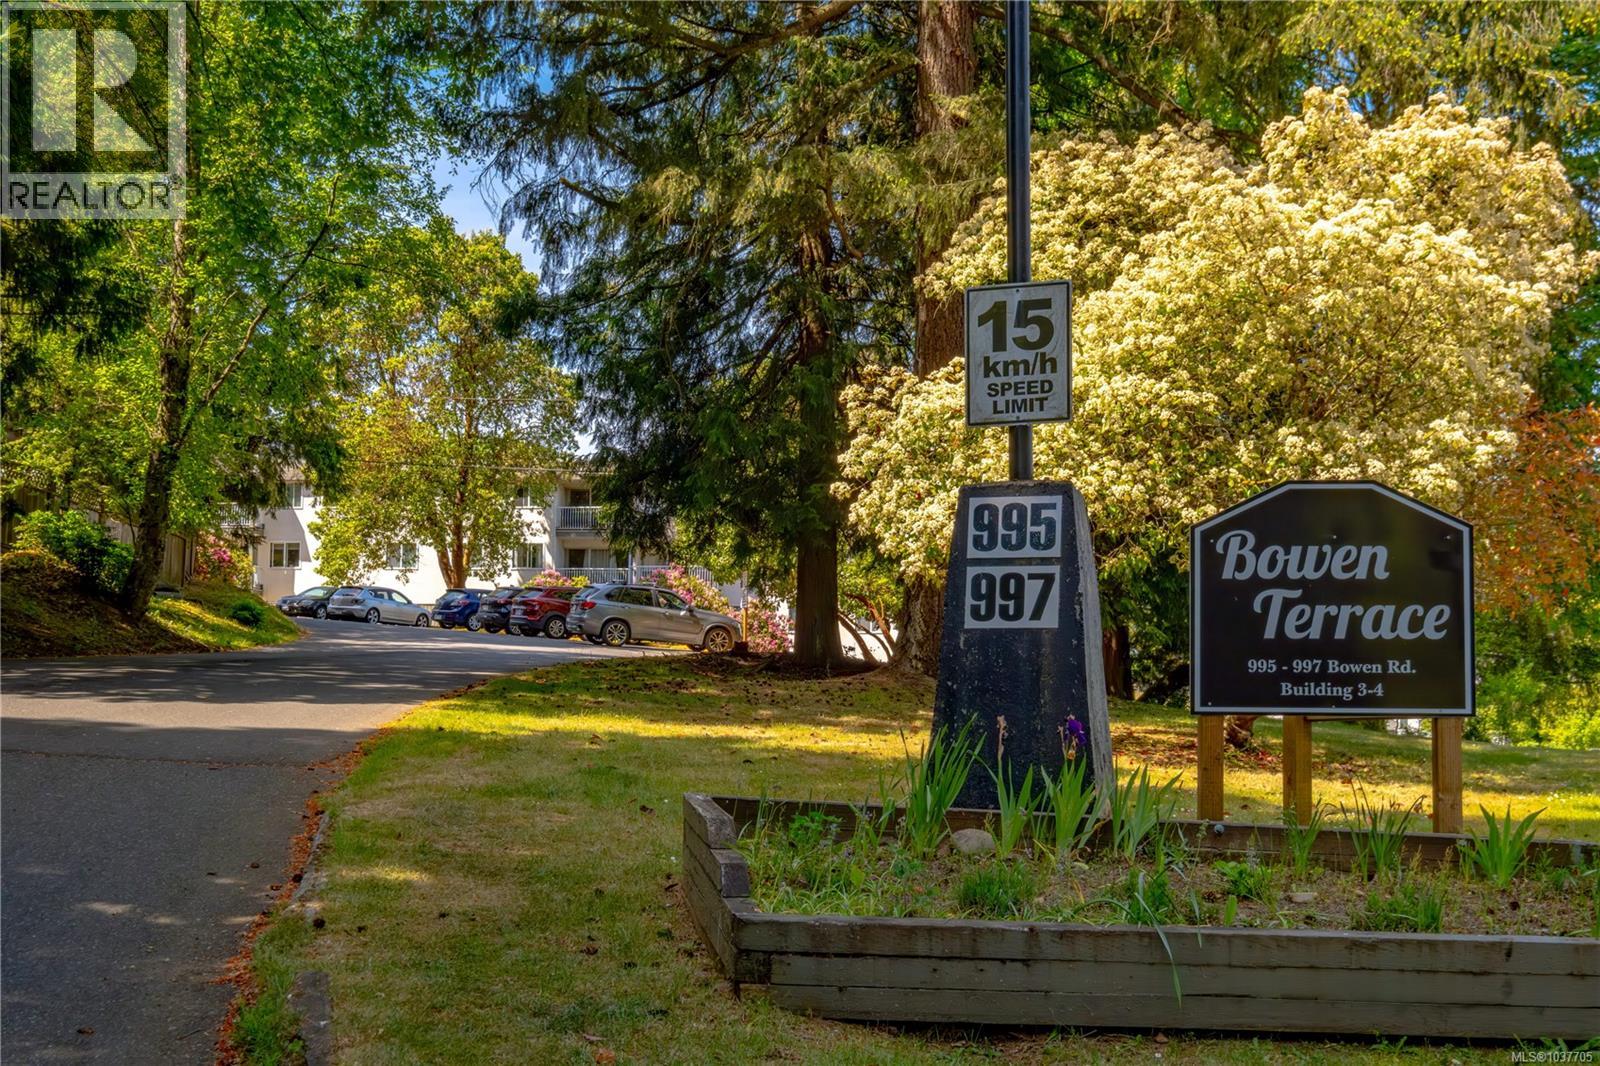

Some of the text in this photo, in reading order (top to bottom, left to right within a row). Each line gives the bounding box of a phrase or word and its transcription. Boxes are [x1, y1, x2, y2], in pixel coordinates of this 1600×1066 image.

[977, 298, 1055, 353] 15
[983, 352, 1057, 378] km/h
[987, 379, 1053, 398] SPEED
[992, 397, 1048, 414] LIMIT
[972, 502, 1057, 552] 995
[1215, 529, 1390, 580] Bowen
[970, 572, 1056, 622] 997
[1253, 588, 1451, 640] Terrace
[1247, 659, 1277, 673] 995
[1292, 659, 1322, 673] 997
[1327, 659, 1383, 674] Bowen
[1387, 659, 1416, 674] Rd.
[1280, 682, 1384, 700] Building 3-4
